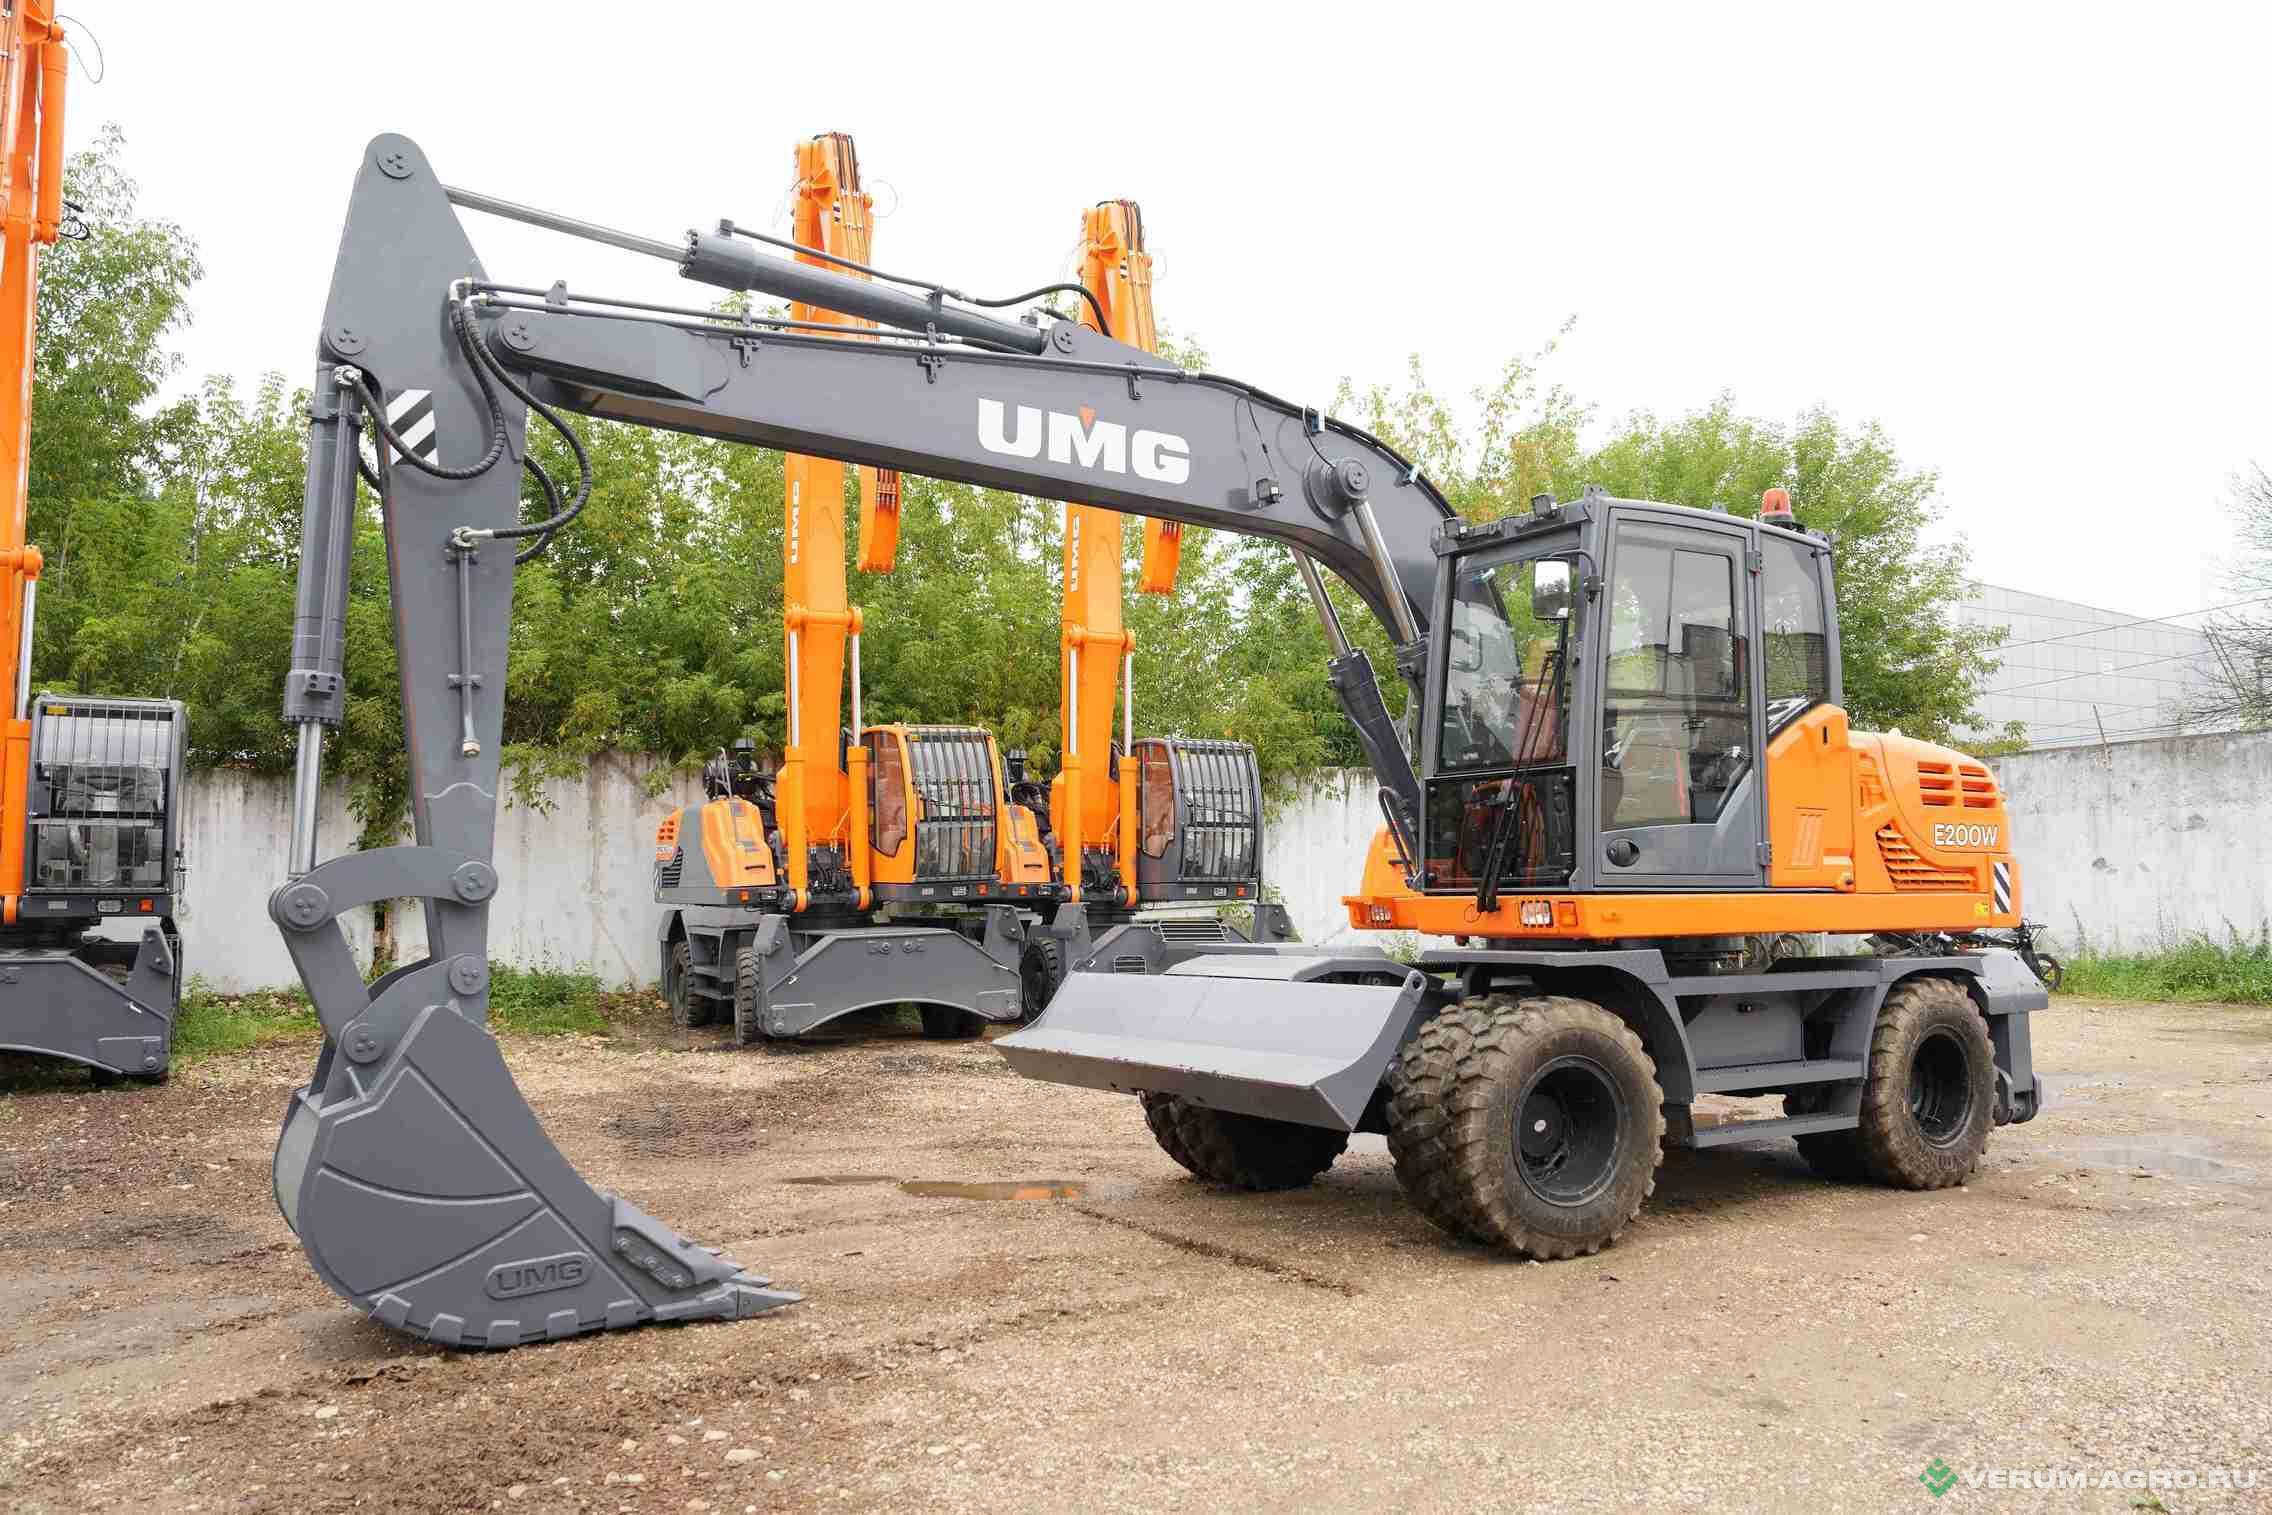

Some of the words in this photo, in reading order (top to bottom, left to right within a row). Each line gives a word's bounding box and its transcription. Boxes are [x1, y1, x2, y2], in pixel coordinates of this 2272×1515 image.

[977, 399, 1190, 484] UMG
[791, 480, 800, 564] UMG
[1071, 515, 1080, 592] UMG
[1934, 823, 1999, 847] E200W
[496, 1261, 583, 1291] UMG
